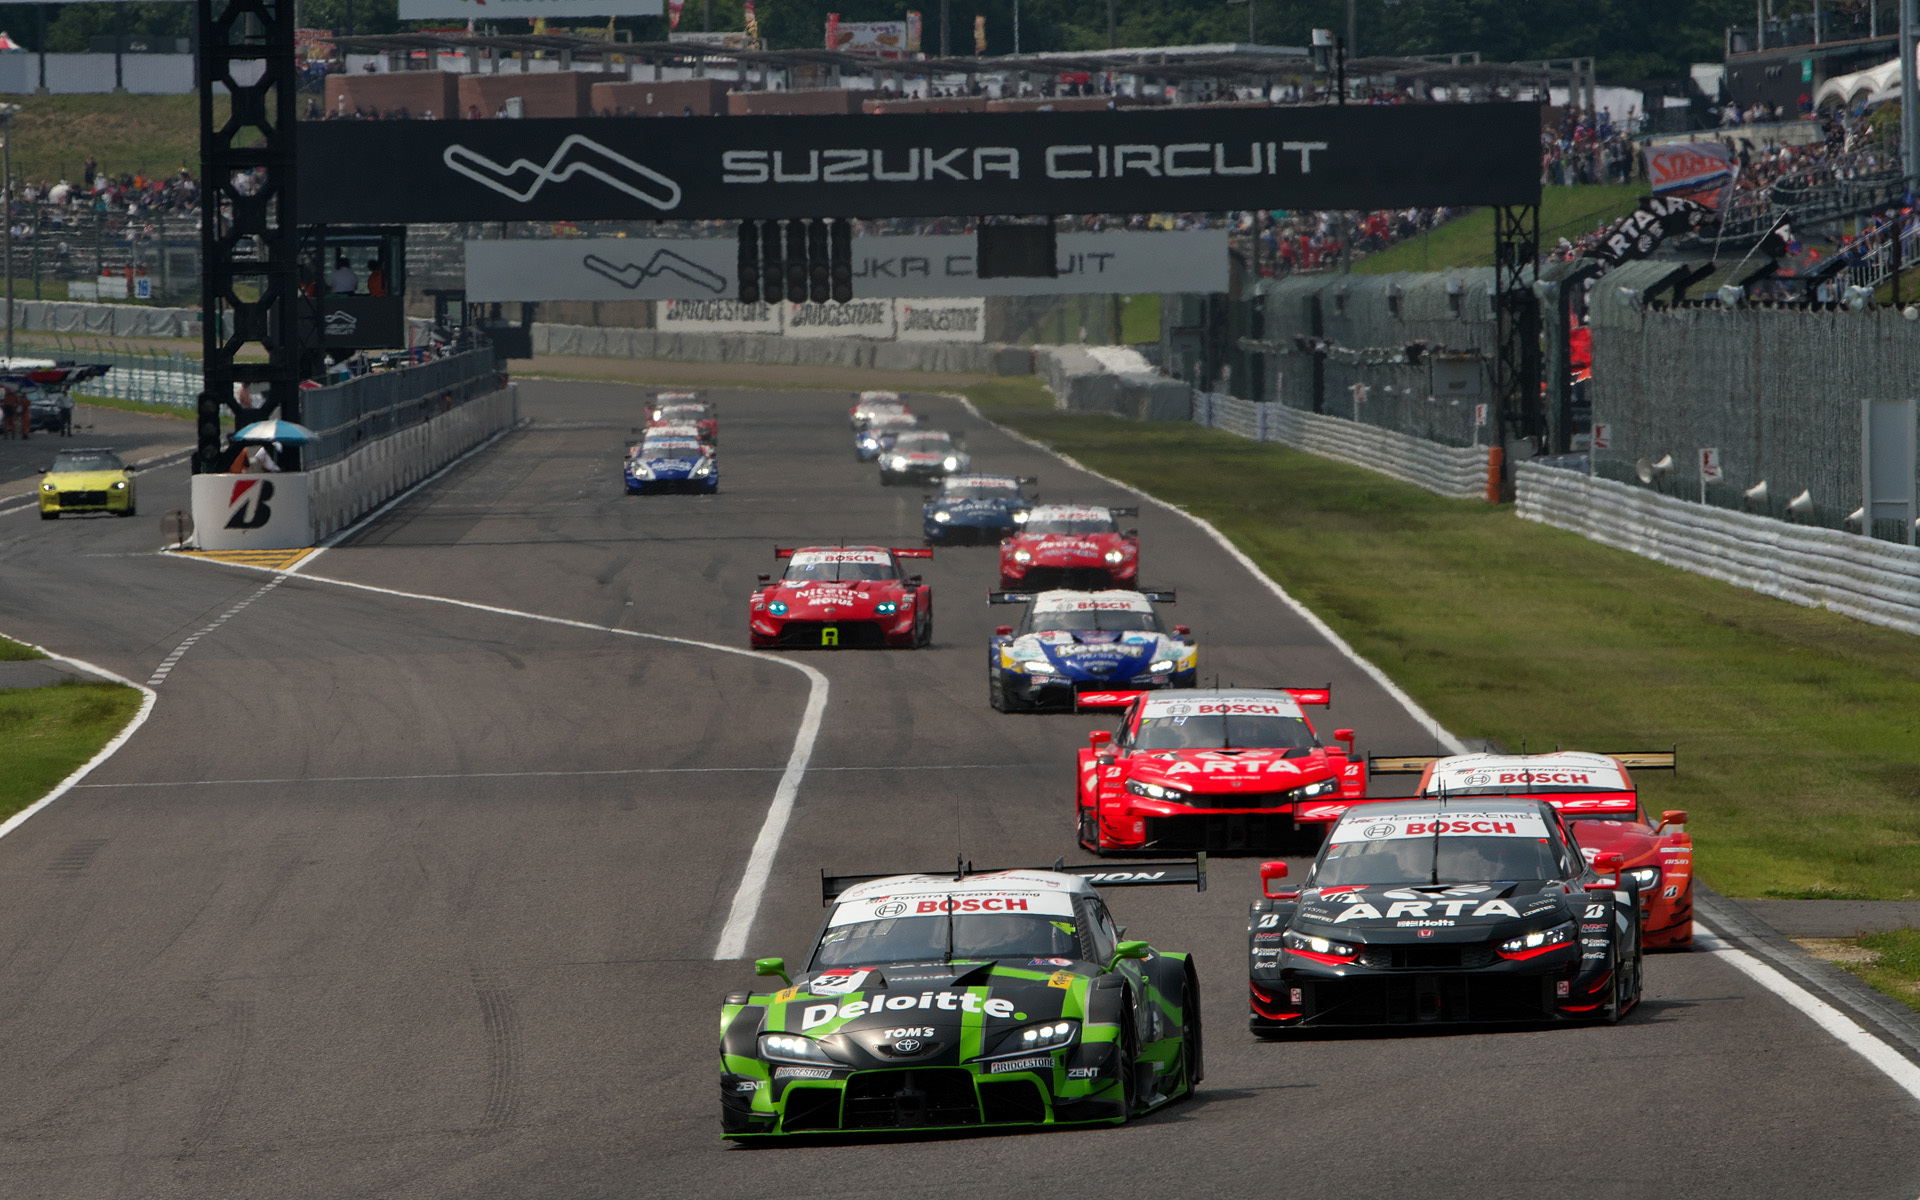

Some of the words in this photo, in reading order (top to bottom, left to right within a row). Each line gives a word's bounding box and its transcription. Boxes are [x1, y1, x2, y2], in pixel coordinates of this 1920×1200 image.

[722, 147, 1020, 184] SUZUKA
[1045, 141, 1328, 179] CIRCUIT
[824, 554, 875, 562] BOSCH
[796, 588, 870, 600] Niterra
[808, 597, 854, 607] MOTUL
[1077, 602, 1132, 610] BOSCH
[1198, 704, 1280, 715] BOSCH
[1165, 759, 1302, 775] ARTA
[1498, 773, 1590, 785] BOSCH
[1405, 820, 1517, 835] BOSCH
[916, 898, 1029, 914] BOSCH
[1333, 899, 1522, 924] ARTA
[1419, 919, 1455, 927] Holts
[884, 1026, 936, 1040] TOM'S
[991, 1057, 1055, 1074] BRIDGESTONE
[774, 1067, 832, 1080] BRIDGESTONE
[1068, 1067, 1101, 1078] ZENT
[736, 1080, 767, 1092] ZENT
